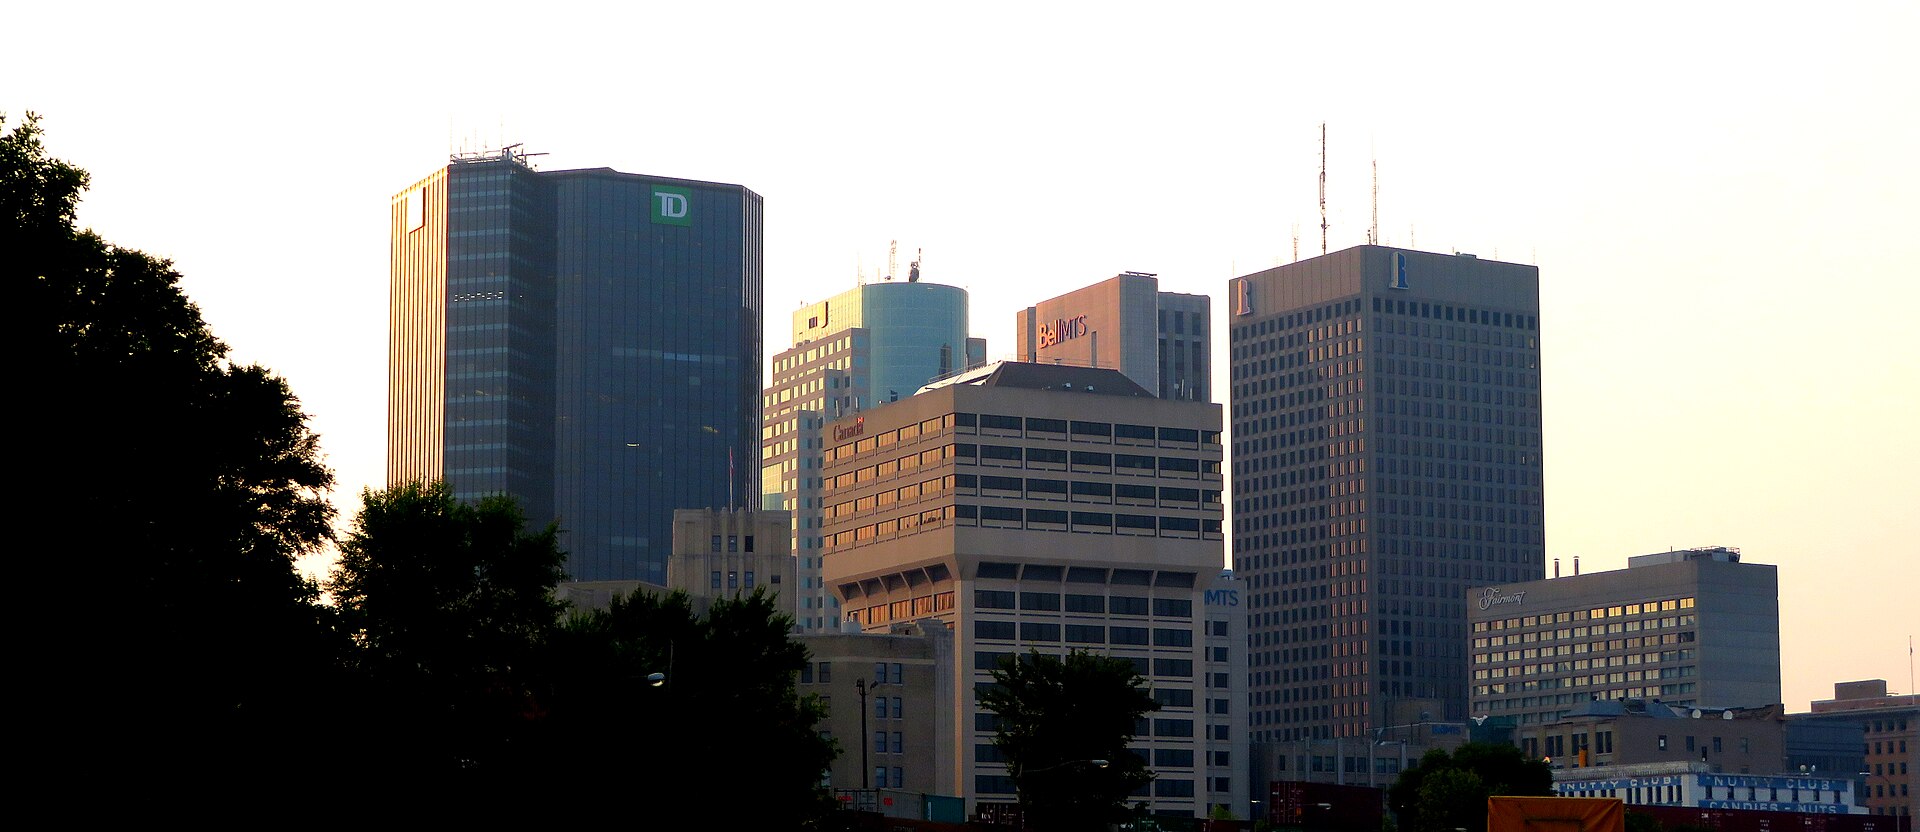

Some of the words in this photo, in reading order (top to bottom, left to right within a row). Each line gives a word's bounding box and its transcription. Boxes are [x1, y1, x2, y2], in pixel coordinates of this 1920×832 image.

[655, 191, 688, 218] TD
[833, 423, 864, 442] Canada
[1479, 587, 1526, 611] Fairmont
[1709, 801, 1778, 812] CANDIES
[1798, 804, 1837, 814] NUTS
